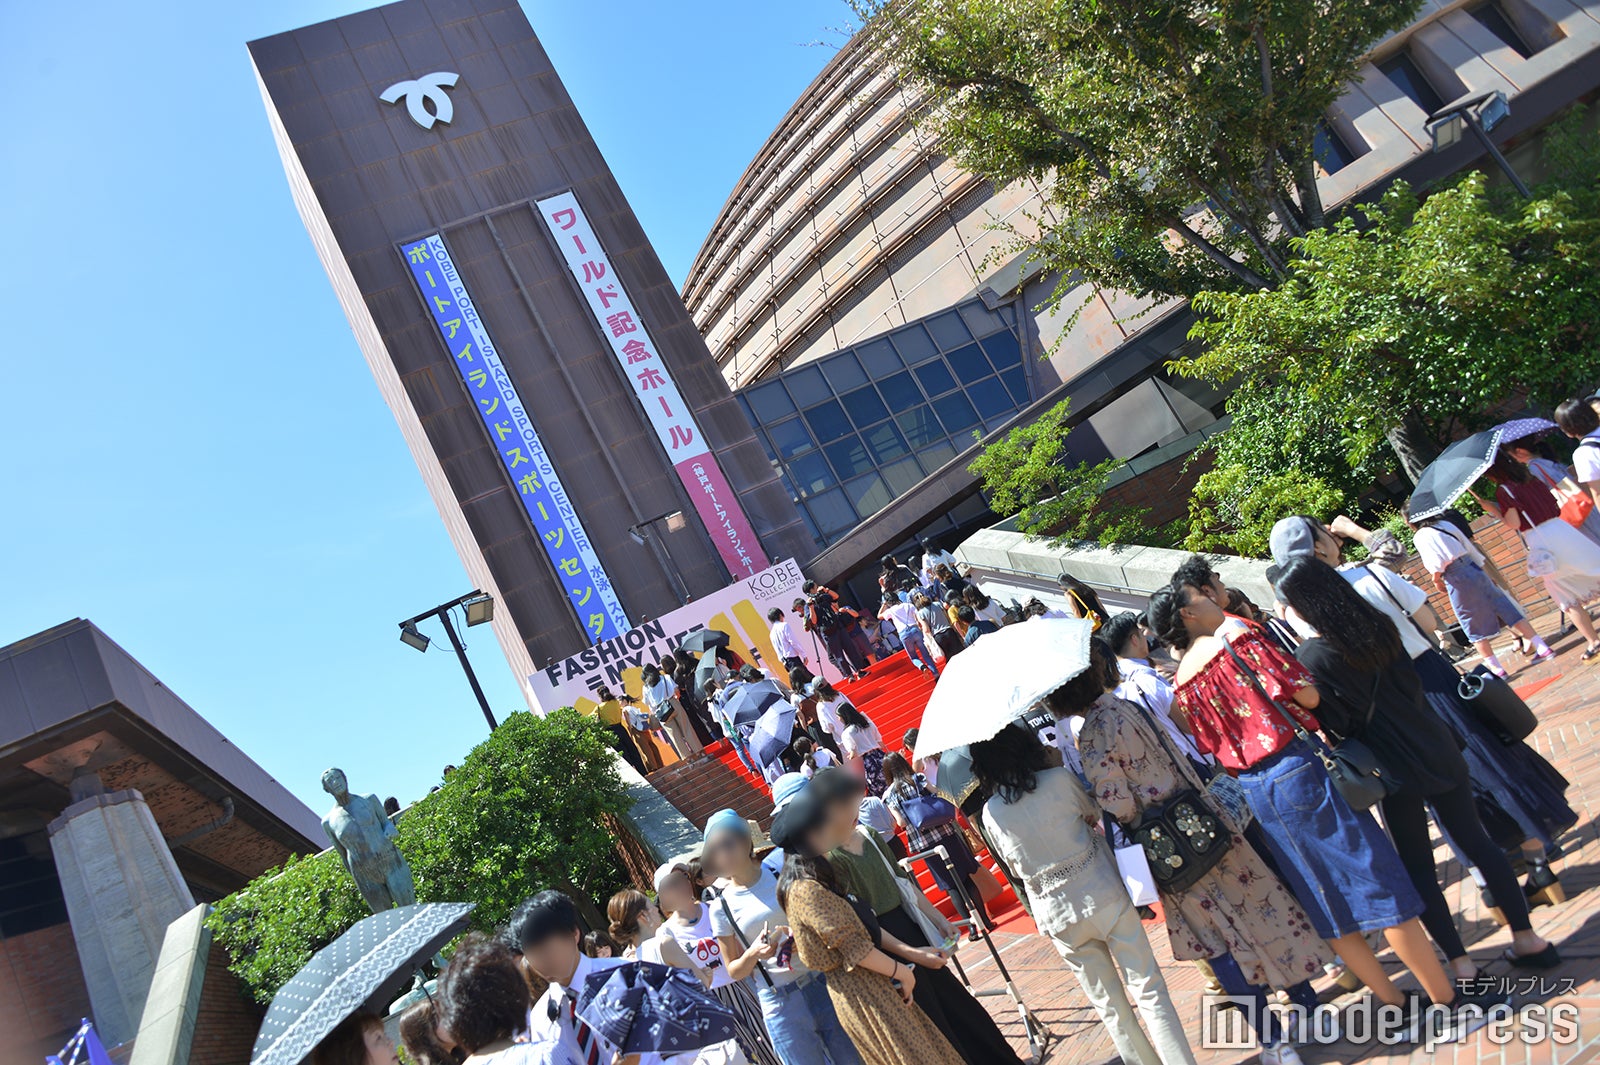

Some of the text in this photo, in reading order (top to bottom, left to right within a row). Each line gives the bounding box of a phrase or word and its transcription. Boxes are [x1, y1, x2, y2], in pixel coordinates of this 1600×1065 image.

[552, 207, 693, 450] ワールド記念ホール
[430, 239, 590, 552] KOBE PORT ISLAND SPORTS CENTER
[747, 562, 798, 595] KOBE
[754, 576, 801, 600] COLLECTION
[545, 619, 666, 688] FASHION
[1027, 715, 1045, 728] TOM
